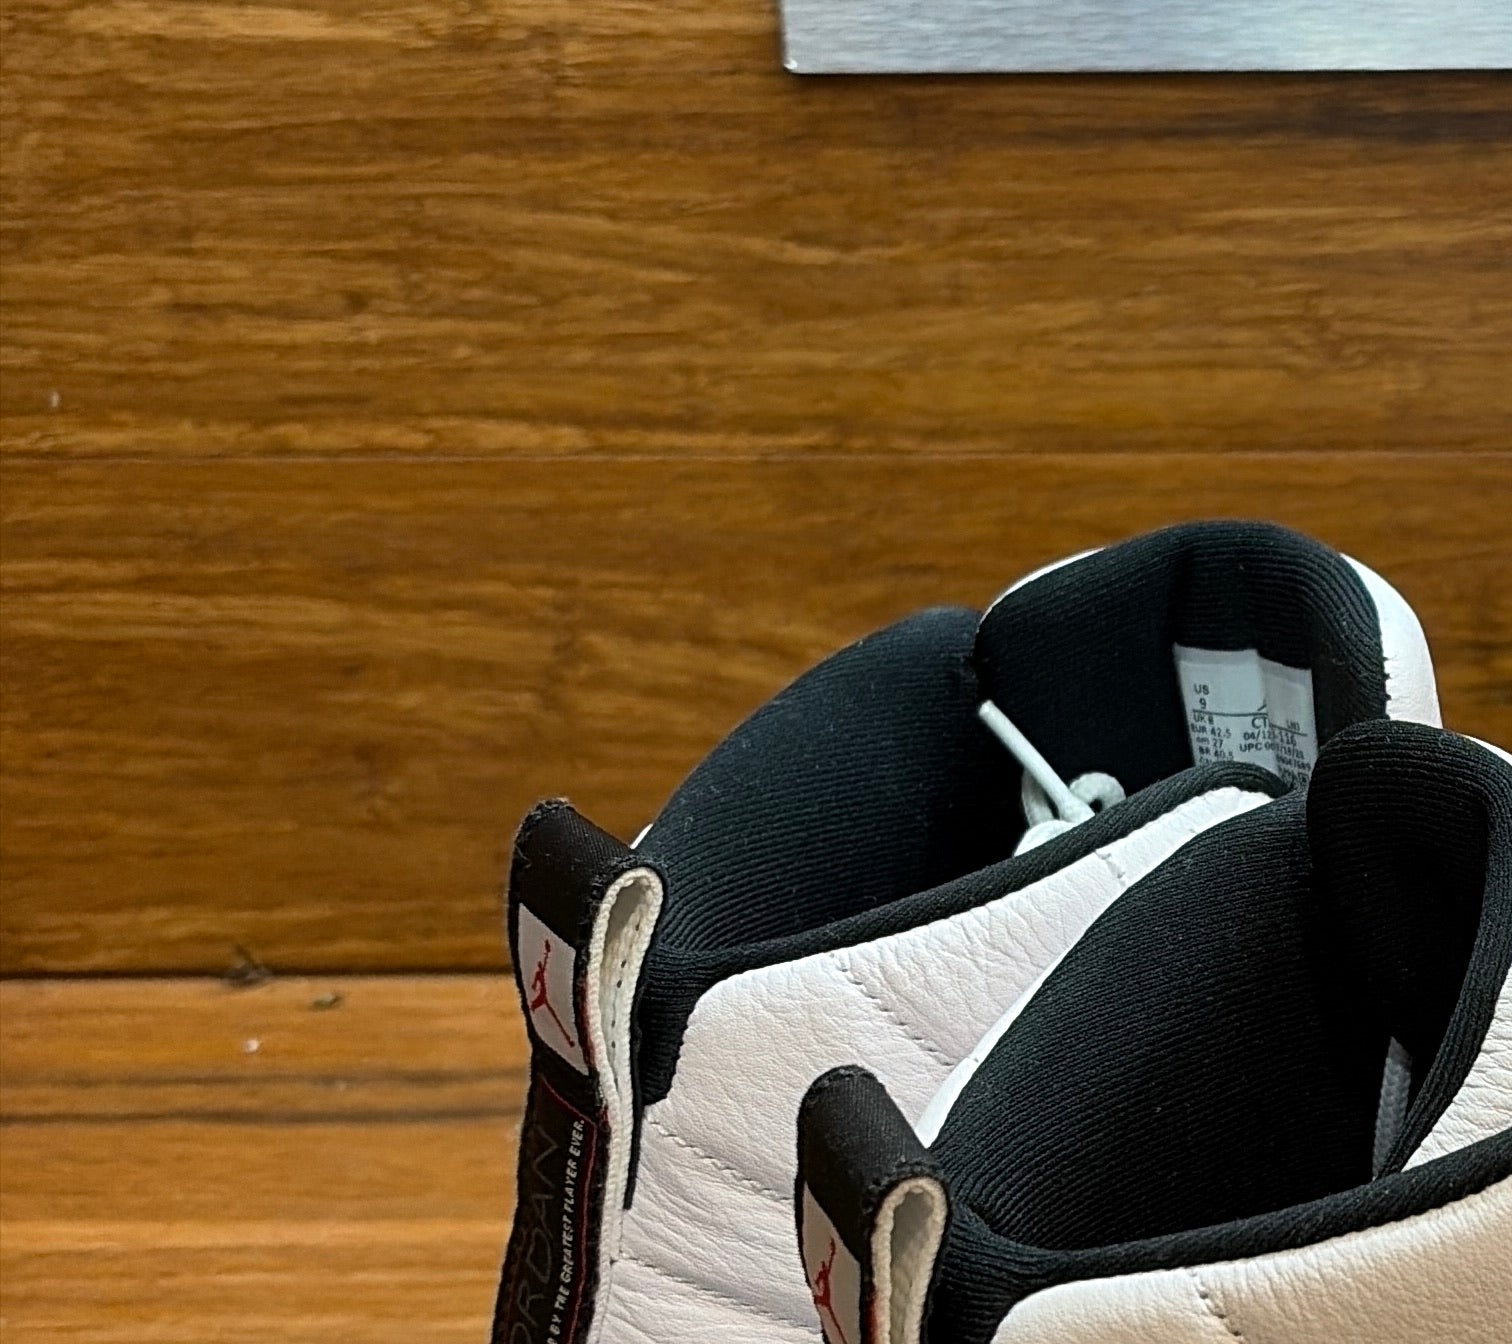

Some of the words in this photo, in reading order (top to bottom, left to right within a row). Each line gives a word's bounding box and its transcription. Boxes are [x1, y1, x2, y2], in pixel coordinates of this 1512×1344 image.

[1193, 683, 1210, 696] US
[563, 1157, 578, 1214] PLAYER
[560, 1214, 575, 1283] GREATEST
[554, 1285, 571, 1311] THE
[549, 1314, 564, 1336] BY
